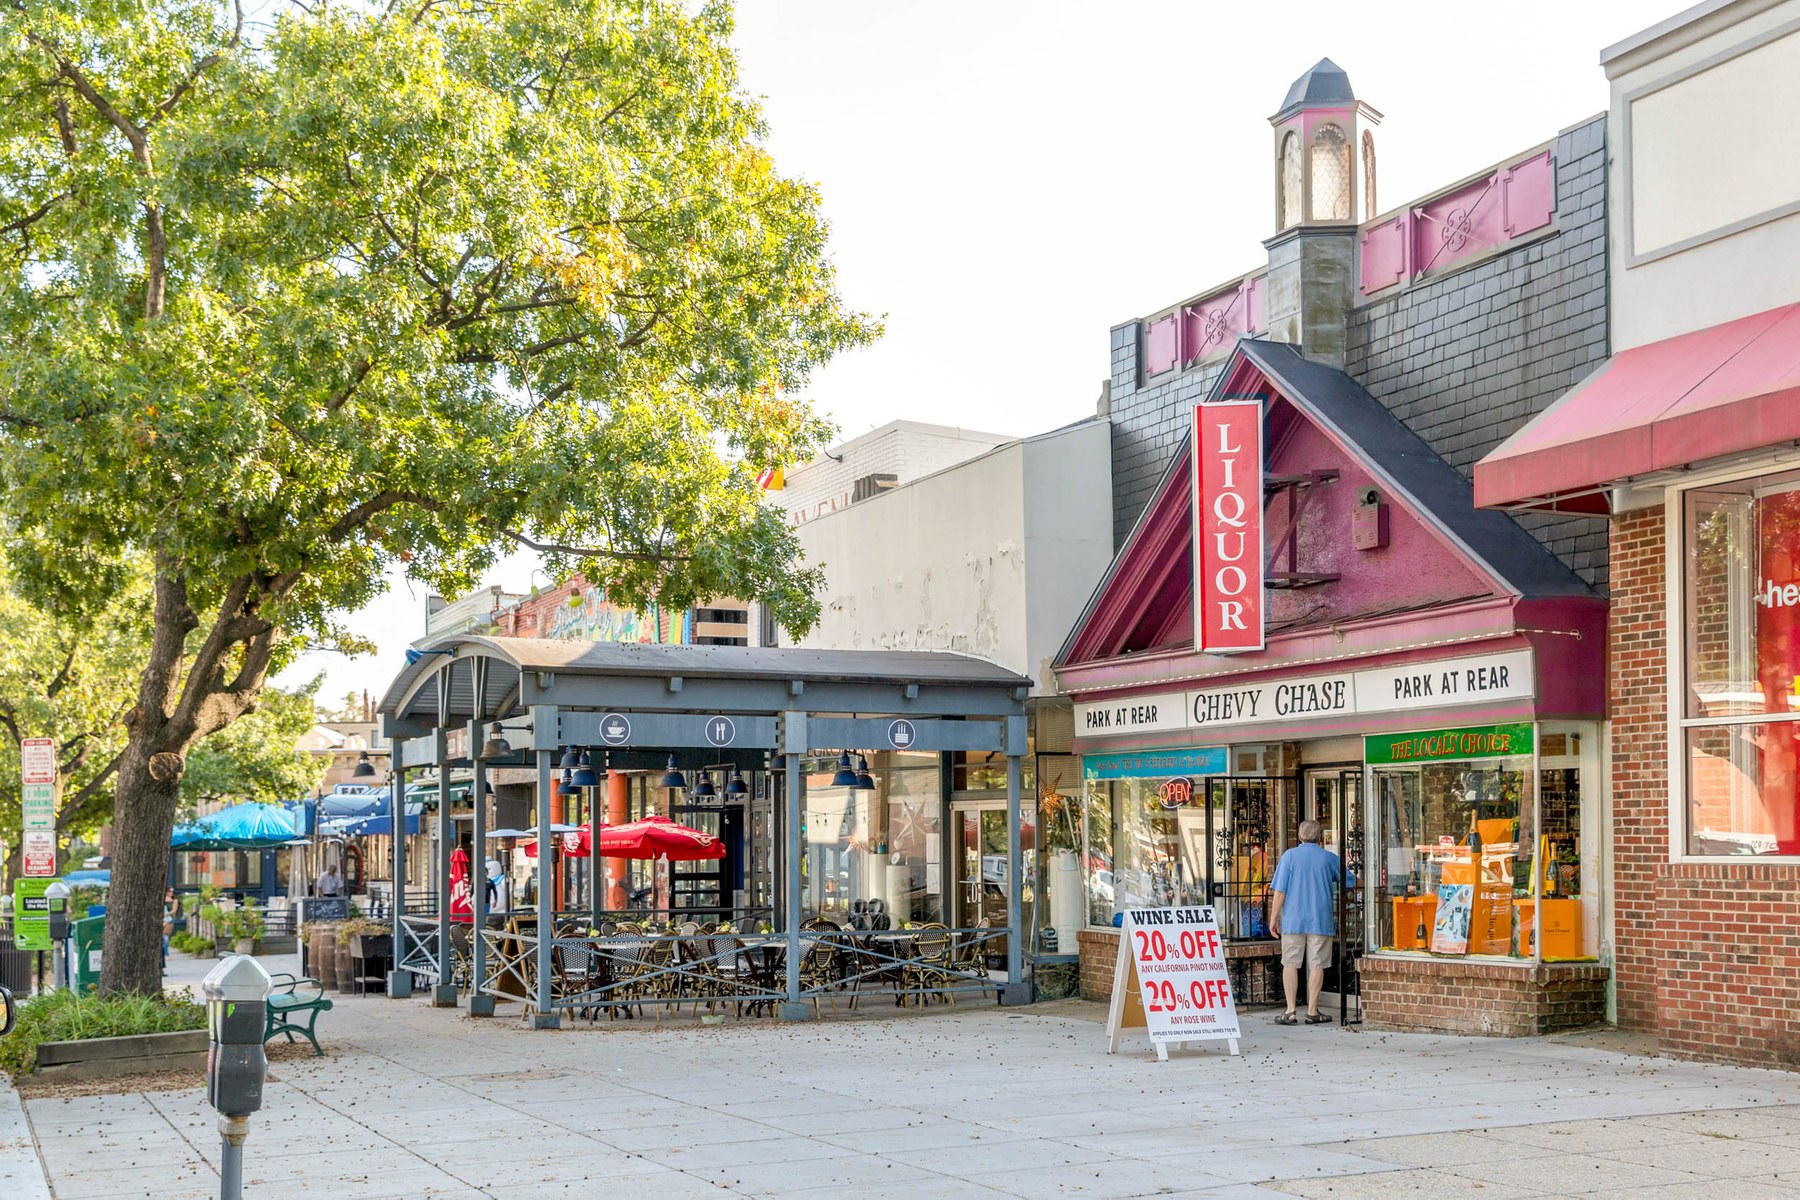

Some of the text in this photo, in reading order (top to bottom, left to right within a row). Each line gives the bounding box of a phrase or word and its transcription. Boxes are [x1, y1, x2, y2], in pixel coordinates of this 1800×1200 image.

[1213, 423, 1248, 631] LIQUOR
[1767, 579, 1800, 608] he
[1394, 665, 1509, 699] PARK AT REAR
[1193, 680, 1345, 724] CHEVY CHASE
[1086, 705, 1158, 729] PARK AT REAR
[1390, 733, 1510, 760] THE LOCALS' CHOICE
[1159, 783, 1190, 802] OPEN
[1130, 909, 1214, 925] WINE SALE
[1135, 930, 1218, 962] 20% OFF
[1142, 962, 1224, 974] ANY CALIFORNIA PINOT NOIR
[1144, 980, 1229, 1012] 20% OFF
[1170, 1015, 1216, 1024] ANY ROSE WINE
